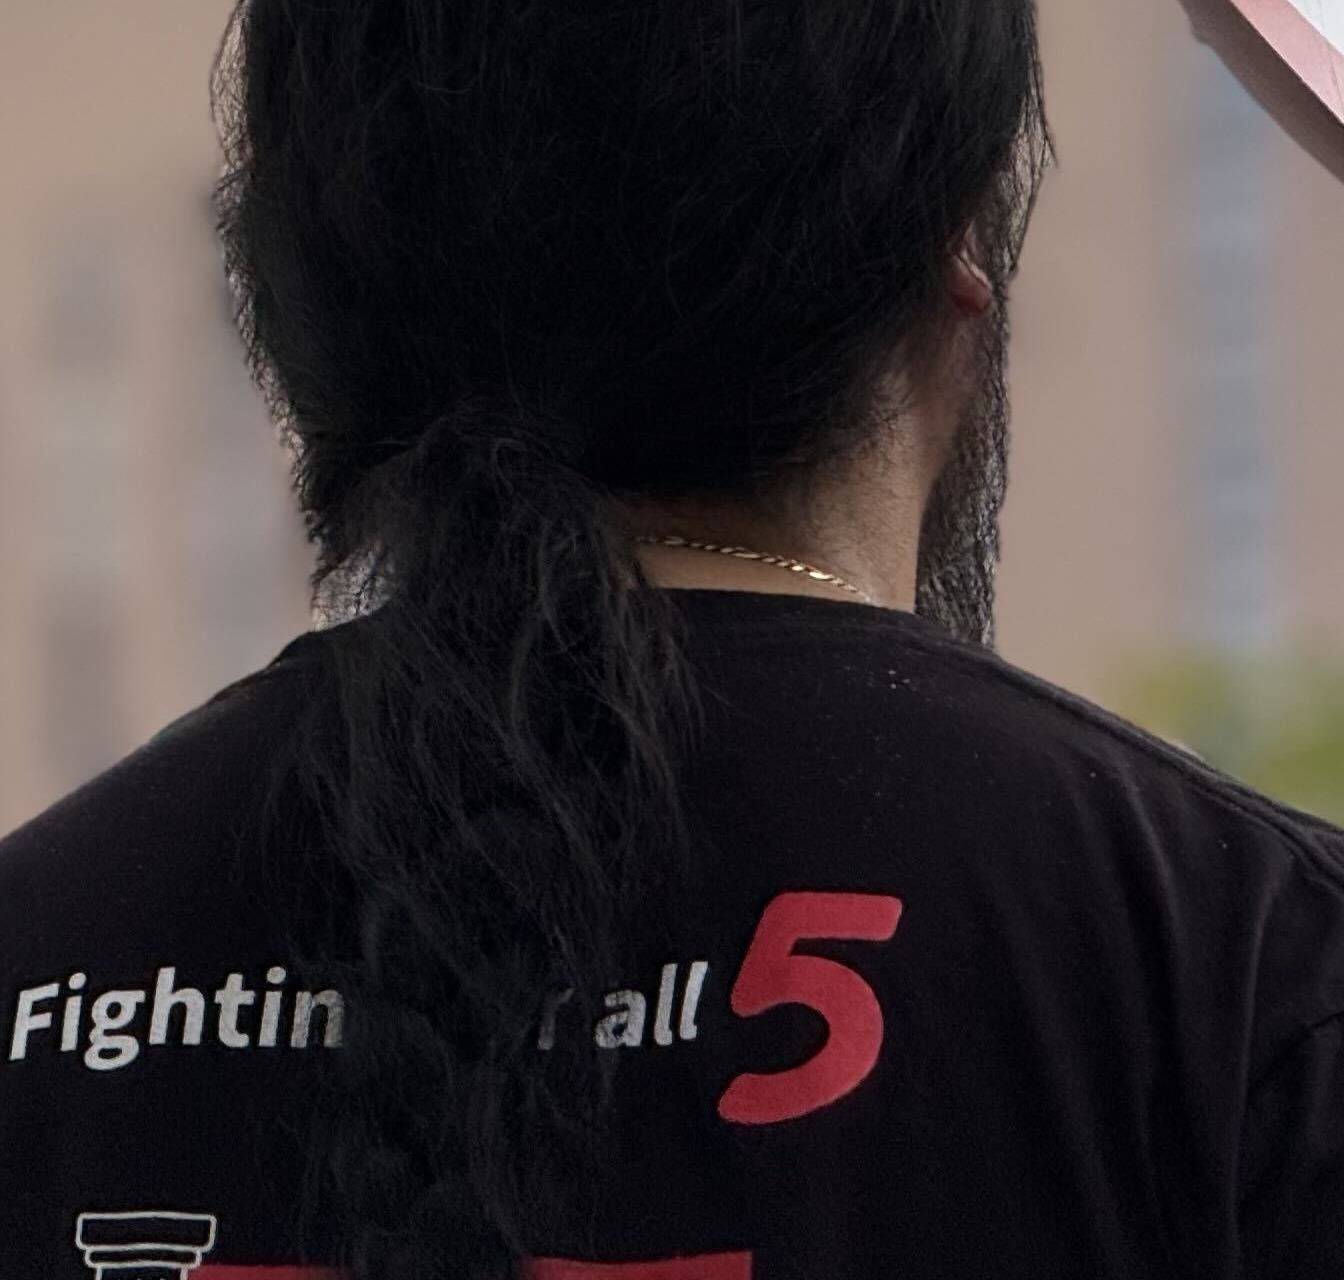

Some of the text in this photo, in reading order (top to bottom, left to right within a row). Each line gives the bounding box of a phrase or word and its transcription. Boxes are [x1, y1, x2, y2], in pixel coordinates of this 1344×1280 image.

[9, 966, 346, 1070] Fightin
[594, 960, 708, 1048] all
[718, 891, 904, 1125] 5
